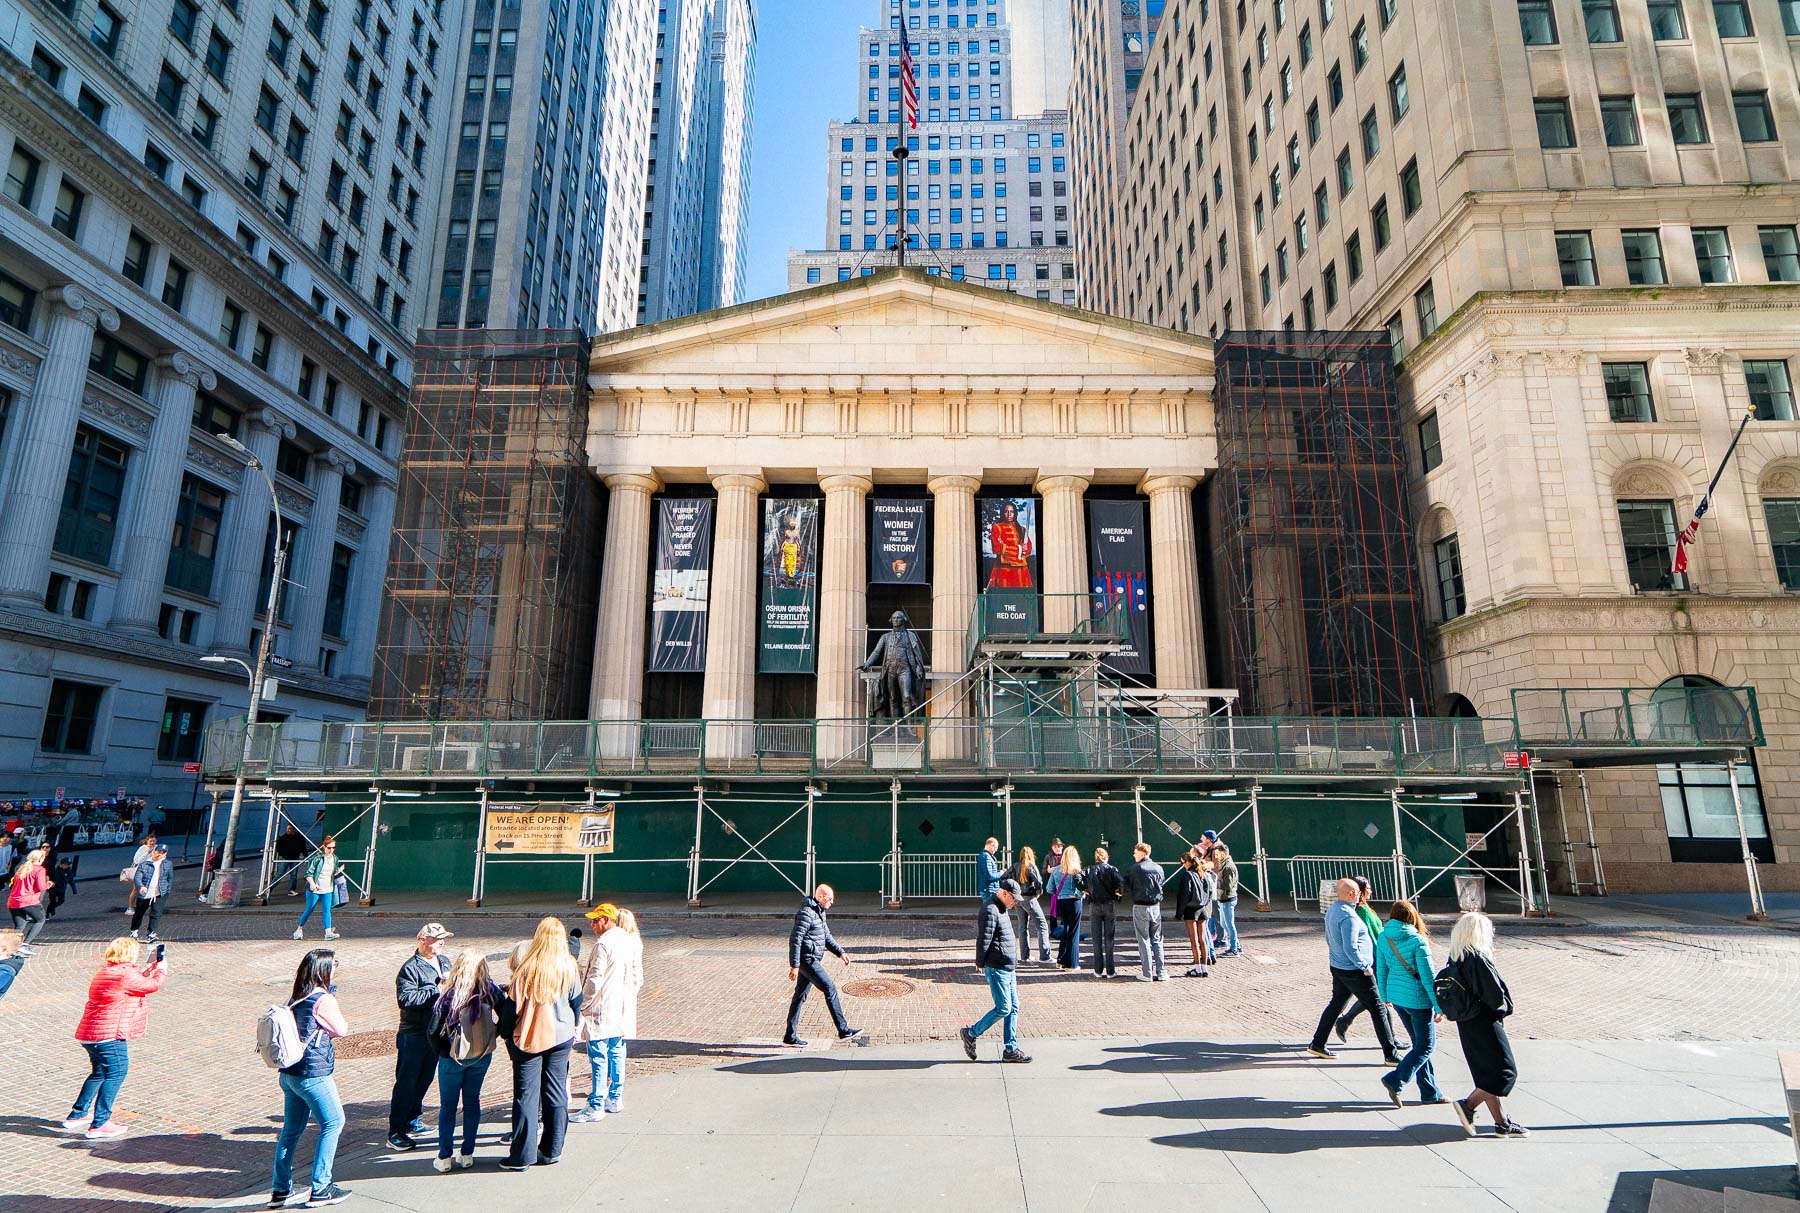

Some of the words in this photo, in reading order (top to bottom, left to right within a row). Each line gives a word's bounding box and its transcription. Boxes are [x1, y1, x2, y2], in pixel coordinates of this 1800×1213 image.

[884, 520, 914, 528] WOMEN
[884, 544, 916, 552] HISTORY
[496, 816, 513, 824] WE
[515, 816, 534, 824] ARE
[538, 815, 569, 824] OPEN!
